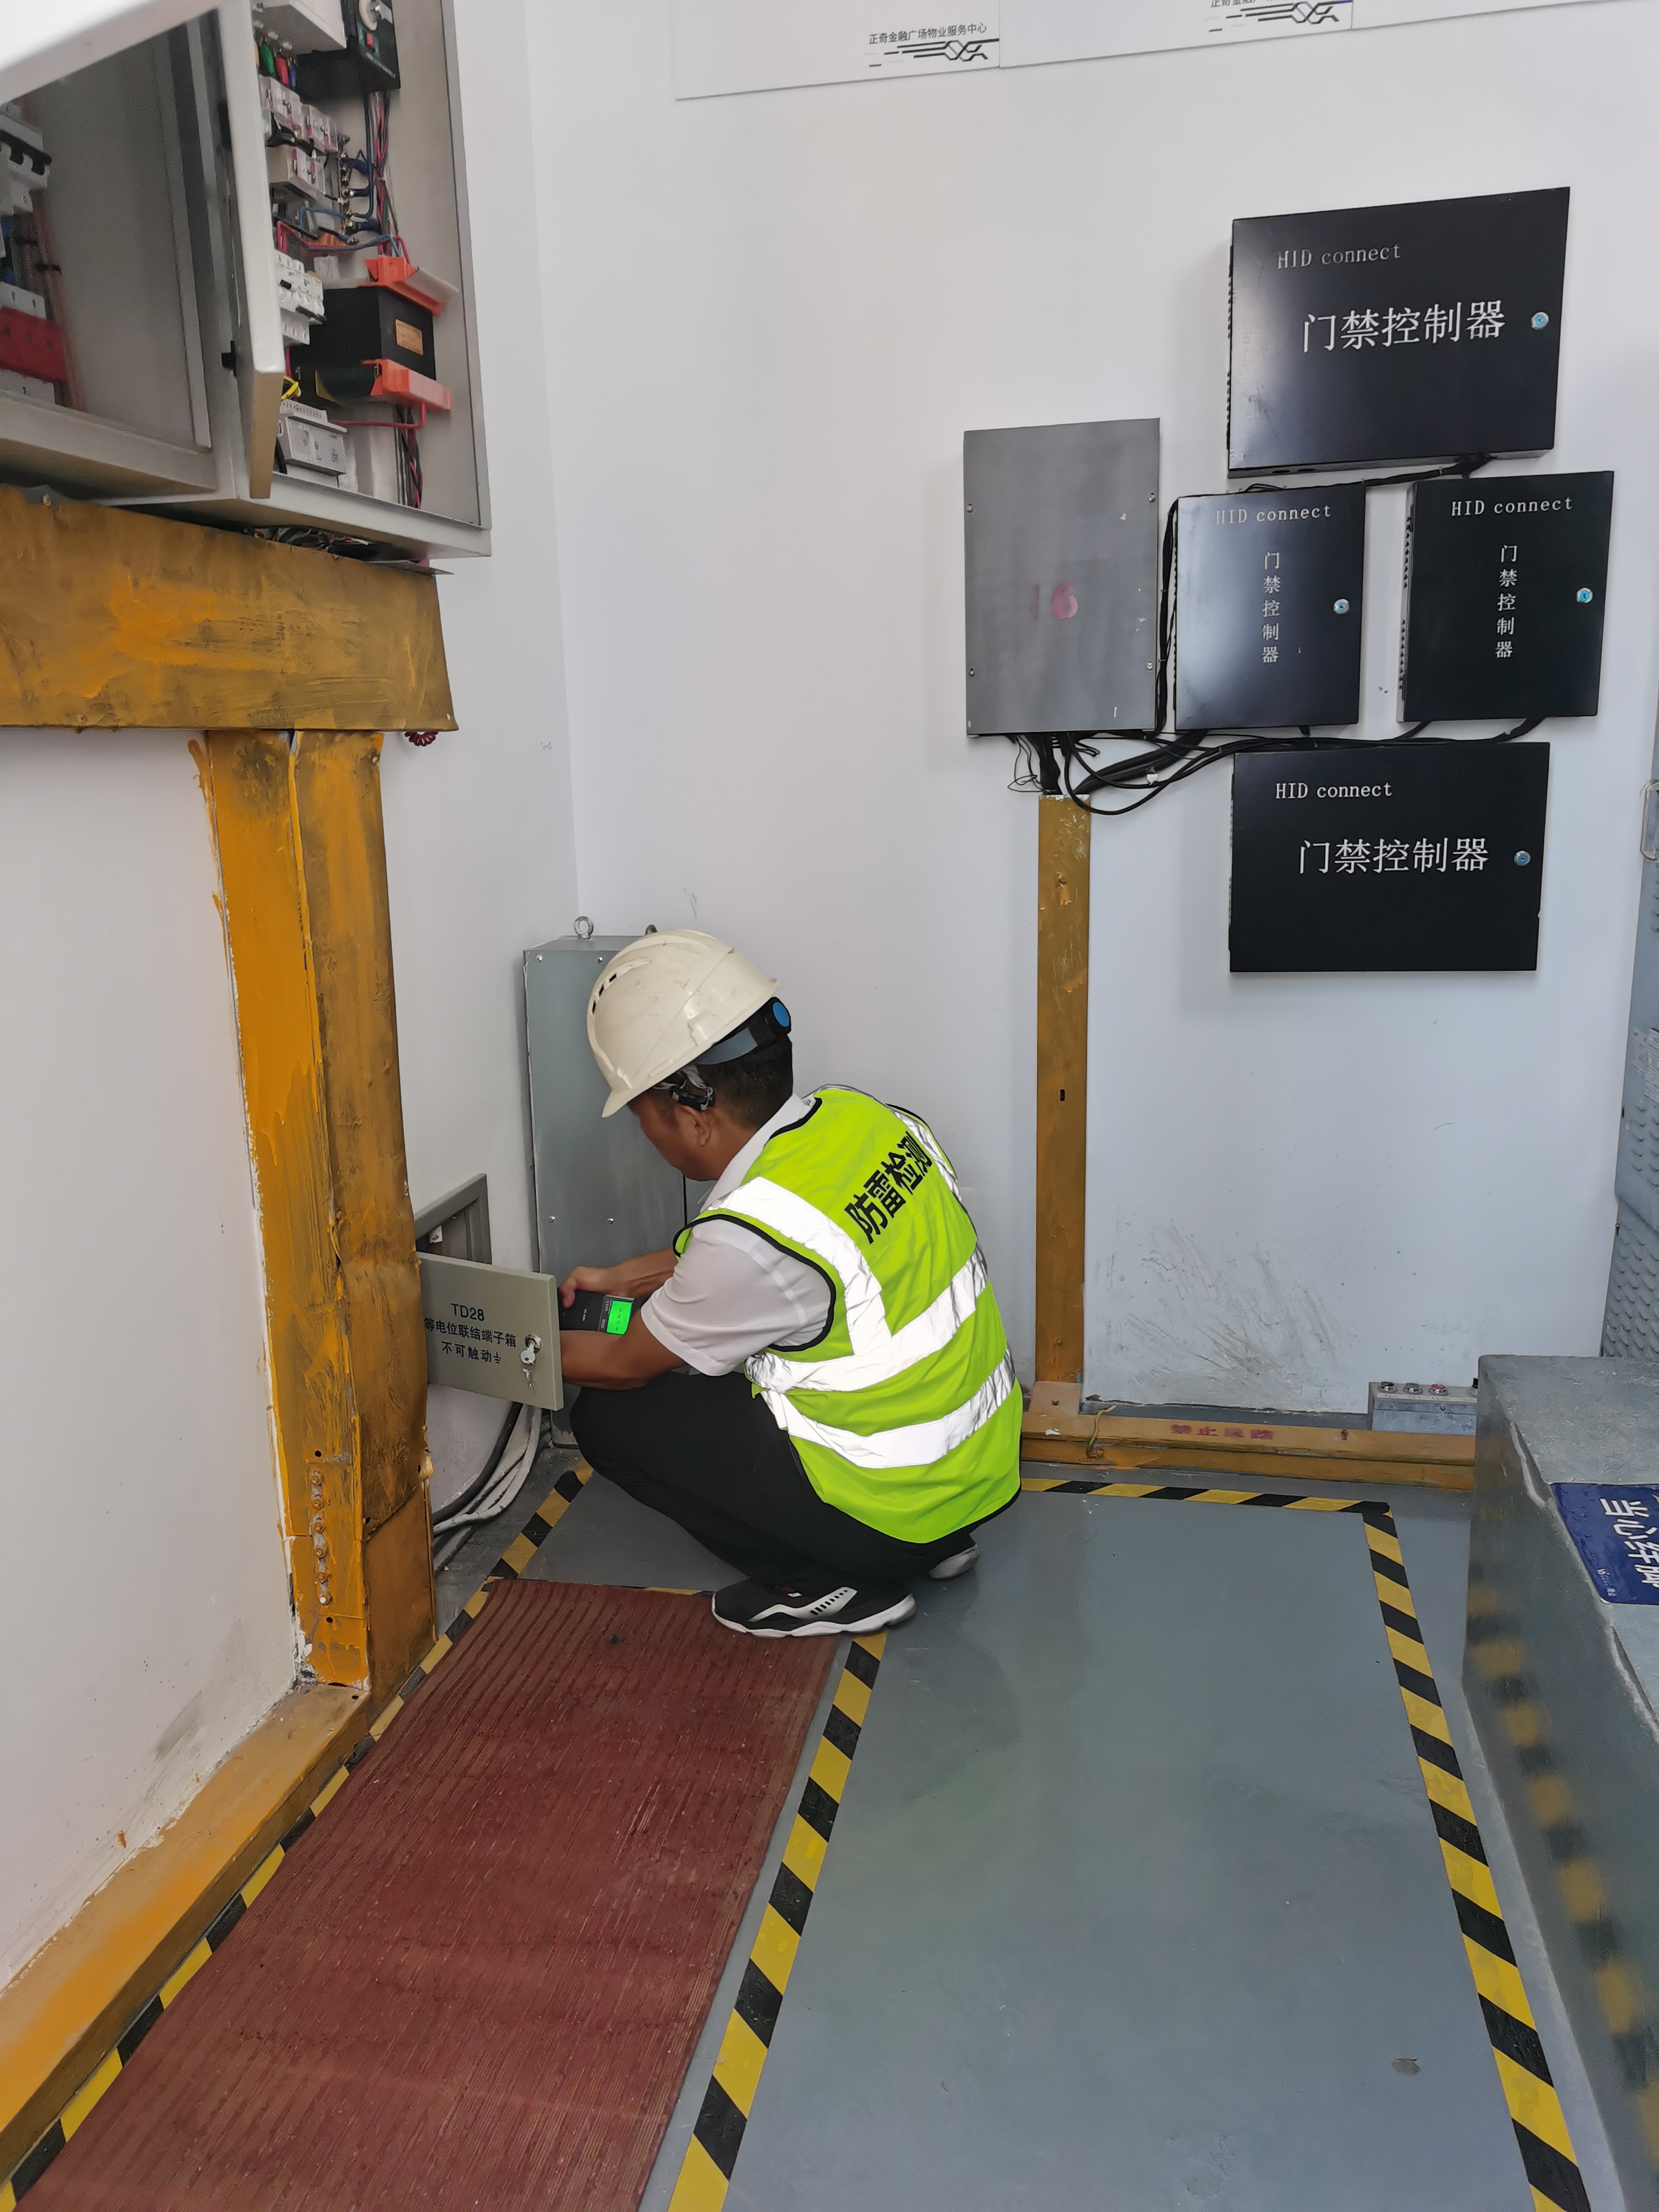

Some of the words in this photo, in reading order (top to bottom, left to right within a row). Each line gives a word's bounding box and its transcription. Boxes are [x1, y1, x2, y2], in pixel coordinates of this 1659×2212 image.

[869, 22, 987, 44] 正奇金融广场物业服务中心
[1278, 249, 1312, 269] HID
[1321, 243, 1401, 266] connect
[1303, 300, 1506, 353] 门禁控制器
[1216, 508, 1247, 525] HID
[1256, 504, 1332, 523] connect
[1452, 500, 1485, 516] HID
[1493, 497, 1574, 514] connect
[1261, 551, 1281, 664] 门禁控制器
[1495, 544, 1518, 659] 门禁控制器
[1275, 782, 1308, 799] HID
[1316, 782, 1393, 798] connect
[1299, 837, 1489, 874] 门禁控制器
[843, 1130, 933, 1245] 防雷检测
[451, 1303, 485, 1321] TD28
[424, 1317, 517, 1348] 等电位联结端子箱
[441, 1340, 492, 1362] 不可触动
